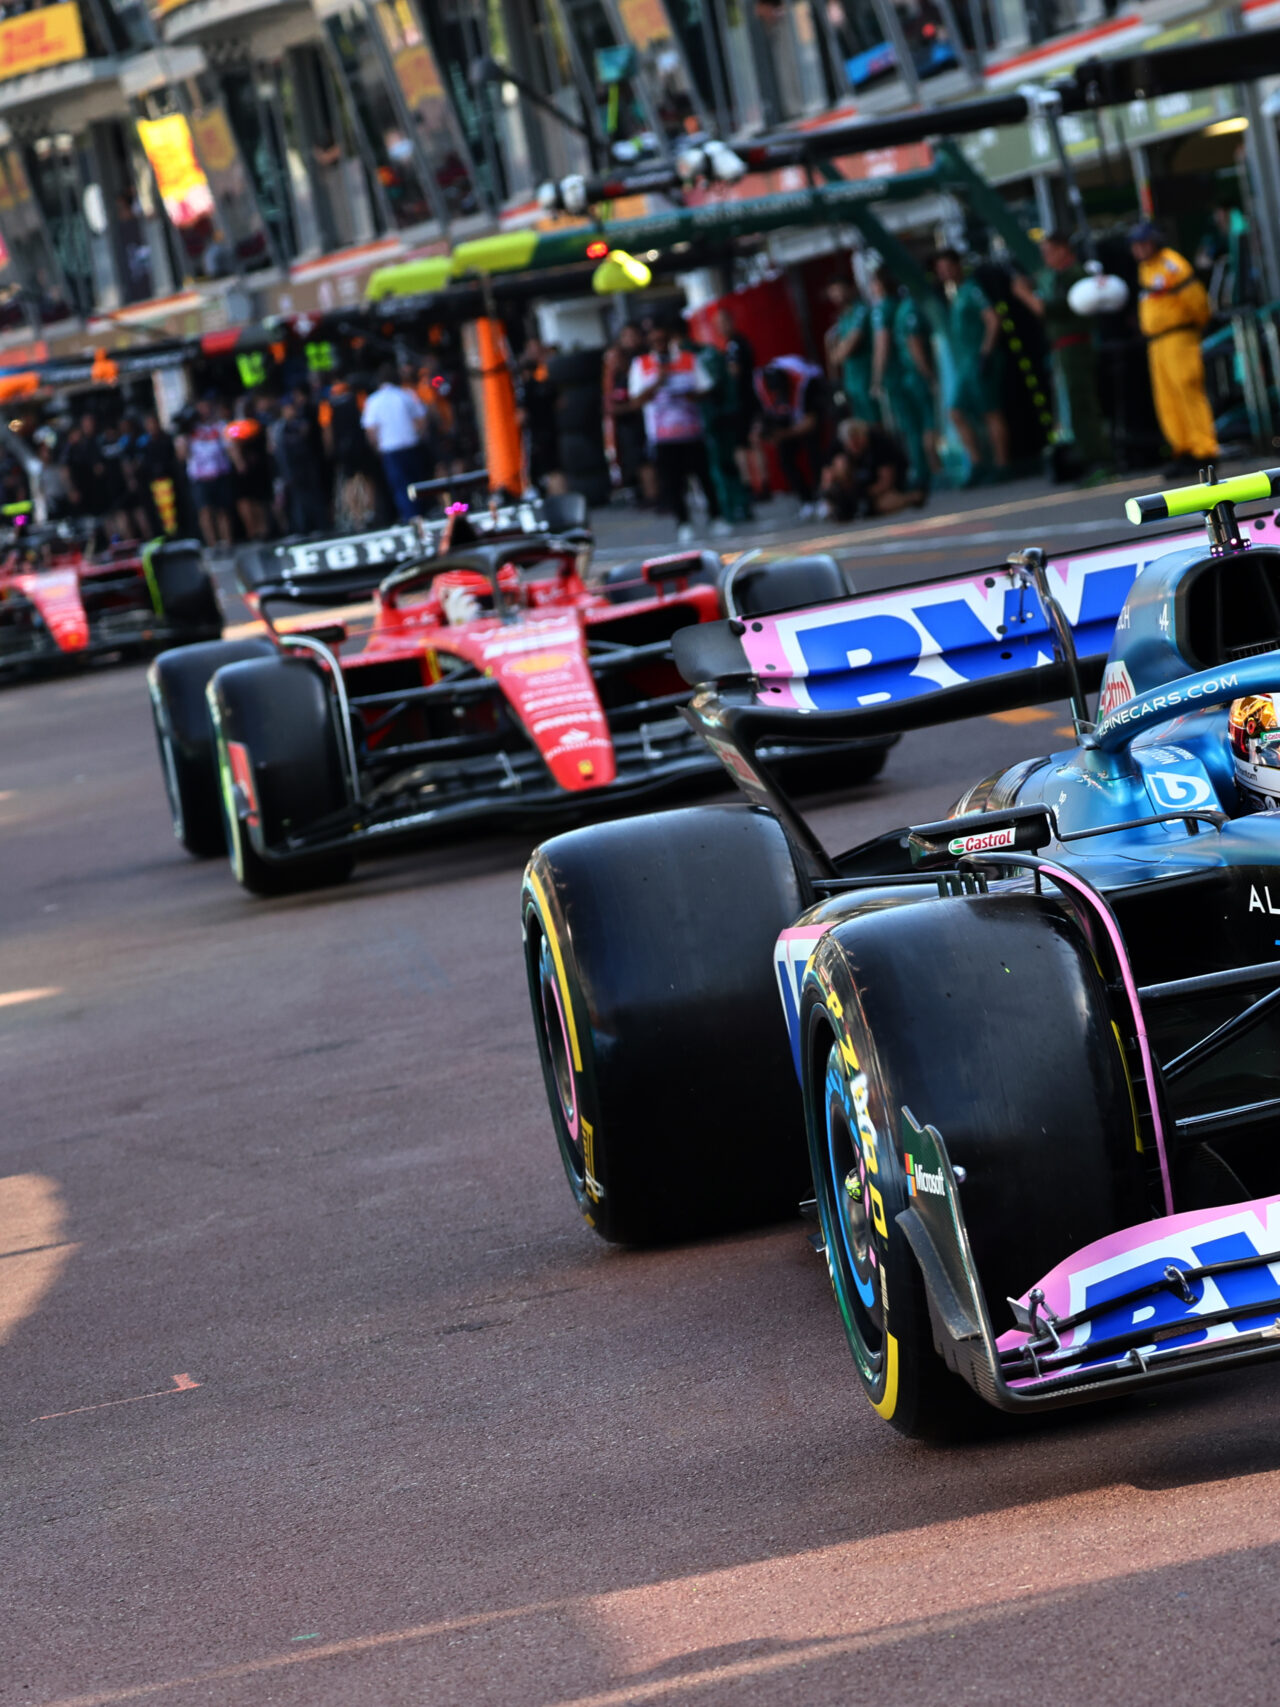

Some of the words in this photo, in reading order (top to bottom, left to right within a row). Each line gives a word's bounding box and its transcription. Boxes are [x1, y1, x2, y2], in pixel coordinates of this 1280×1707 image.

[790, 560, 1150, 711] BW
[966, 829, 1012, 851] Castrol
[914, 1163, 946, 1196] Microsoft
